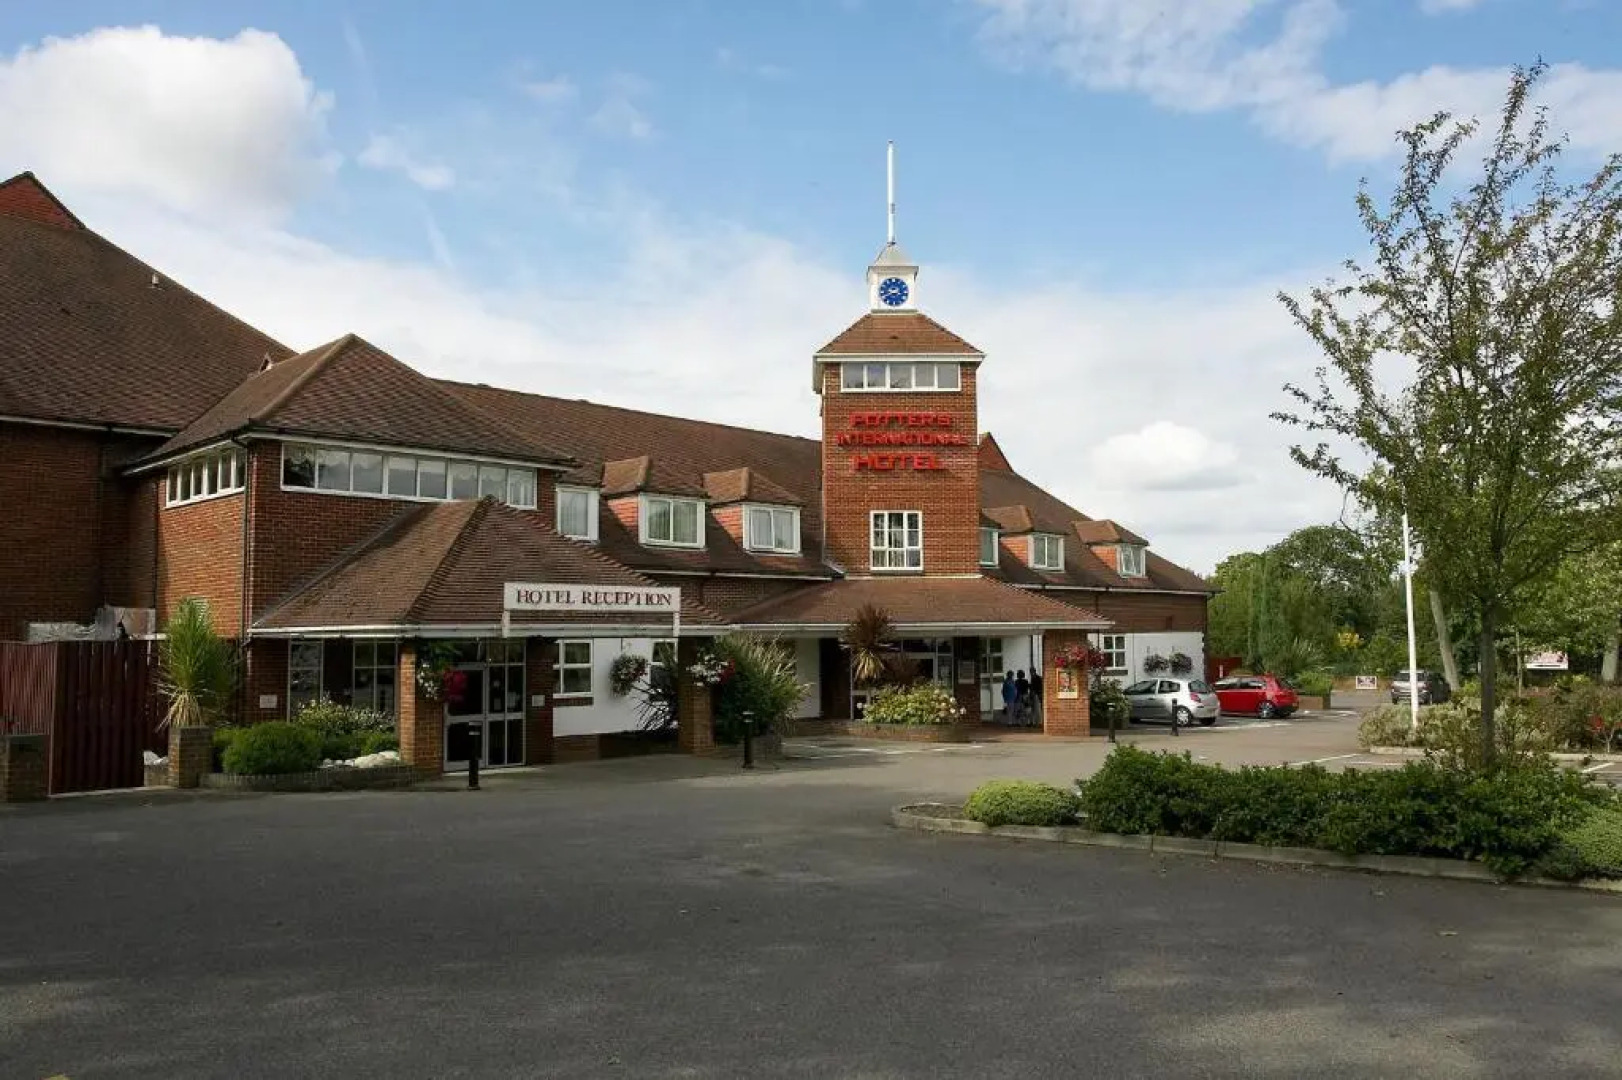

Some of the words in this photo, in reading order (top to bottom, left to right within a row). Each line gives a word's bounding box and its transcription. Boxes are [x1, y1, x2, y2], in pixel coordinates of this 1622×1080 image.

[836, 432, 968, 446] INTERNATIONAL
[853, 453, 943, 470] HOTEL
[517, 589, 575, 605] HOTEL
[582, 591, 672, 606] RECEPTION
